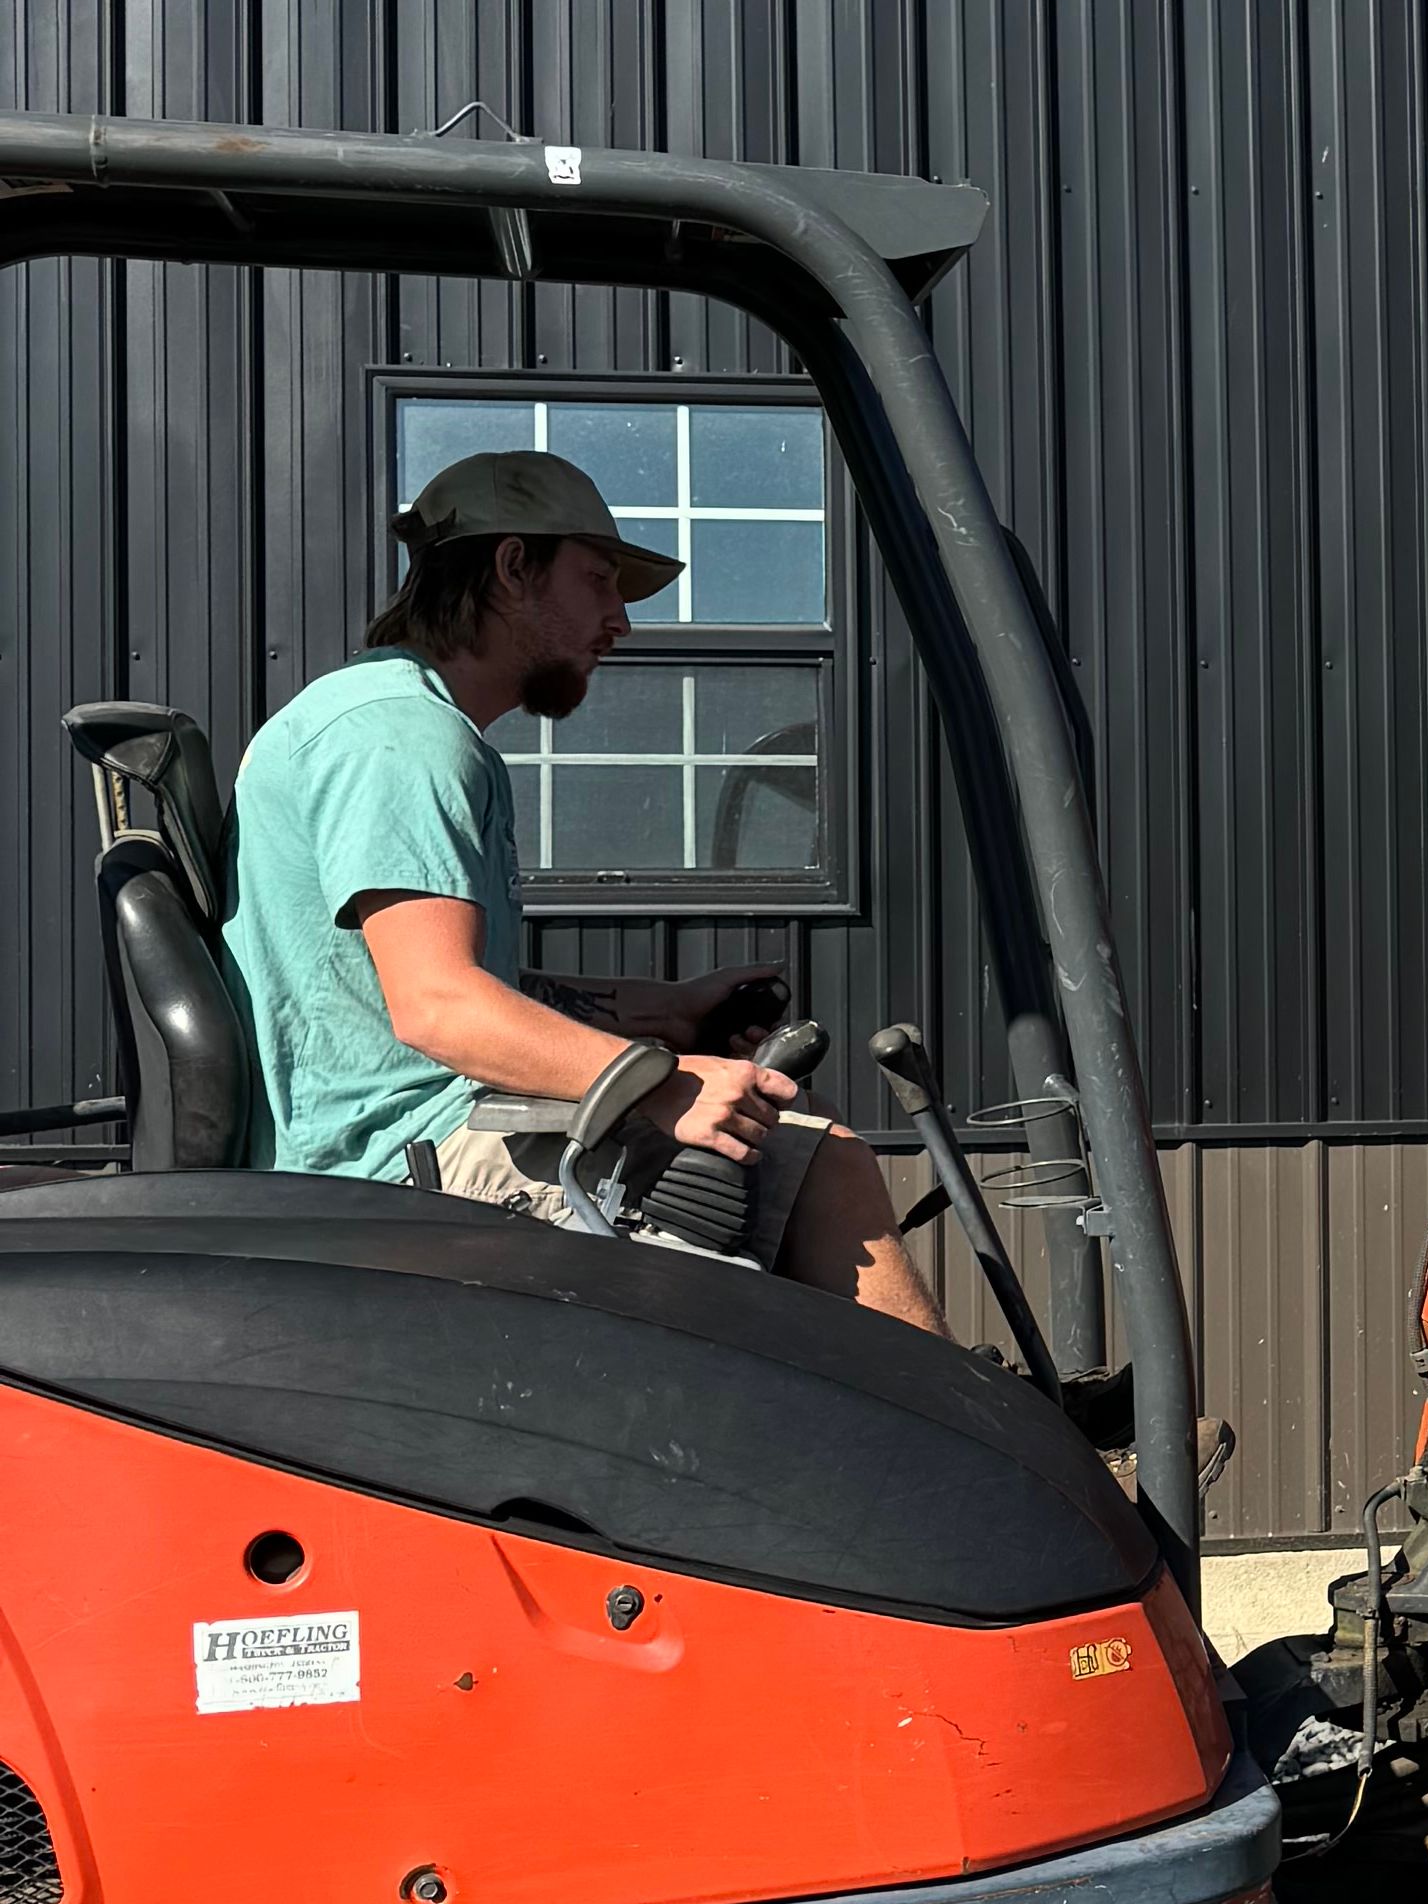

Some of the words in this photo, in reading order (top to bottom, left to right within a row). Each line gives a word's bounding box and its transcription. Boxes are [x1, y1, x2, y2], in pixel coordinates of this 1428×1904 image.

[203, 1624, 348, 1662] HOEFLING
[285, 1645, 295, 1655] &
[300, 1642, 347, 1654] TRACTOR
